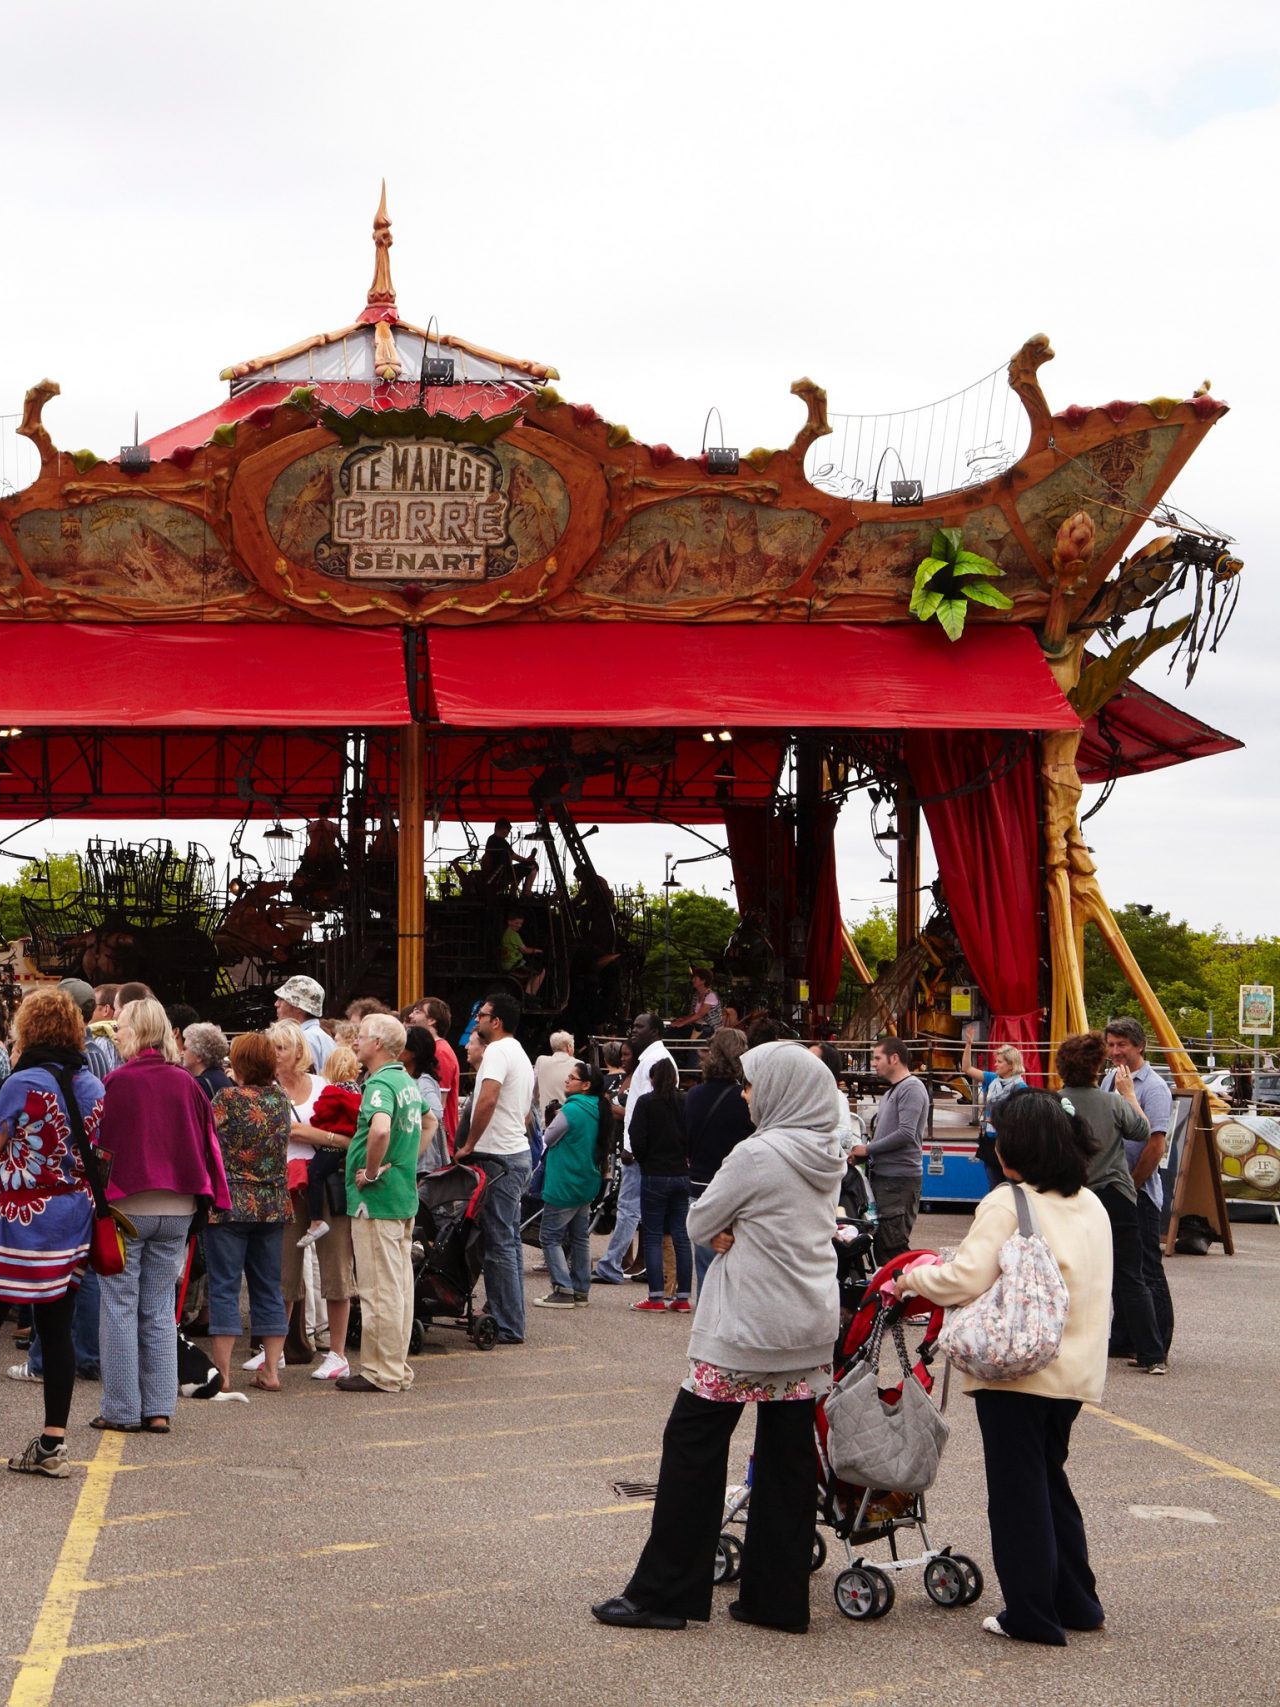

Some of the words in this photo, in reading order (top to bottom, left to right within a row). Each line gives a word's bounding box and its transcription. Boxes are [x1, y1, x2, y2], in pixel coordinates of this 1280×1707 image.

[357, 457, 382, 492] LE
[353, 547, 482, 571] SÉNART
[370, 1089, 382, 1107] 4
